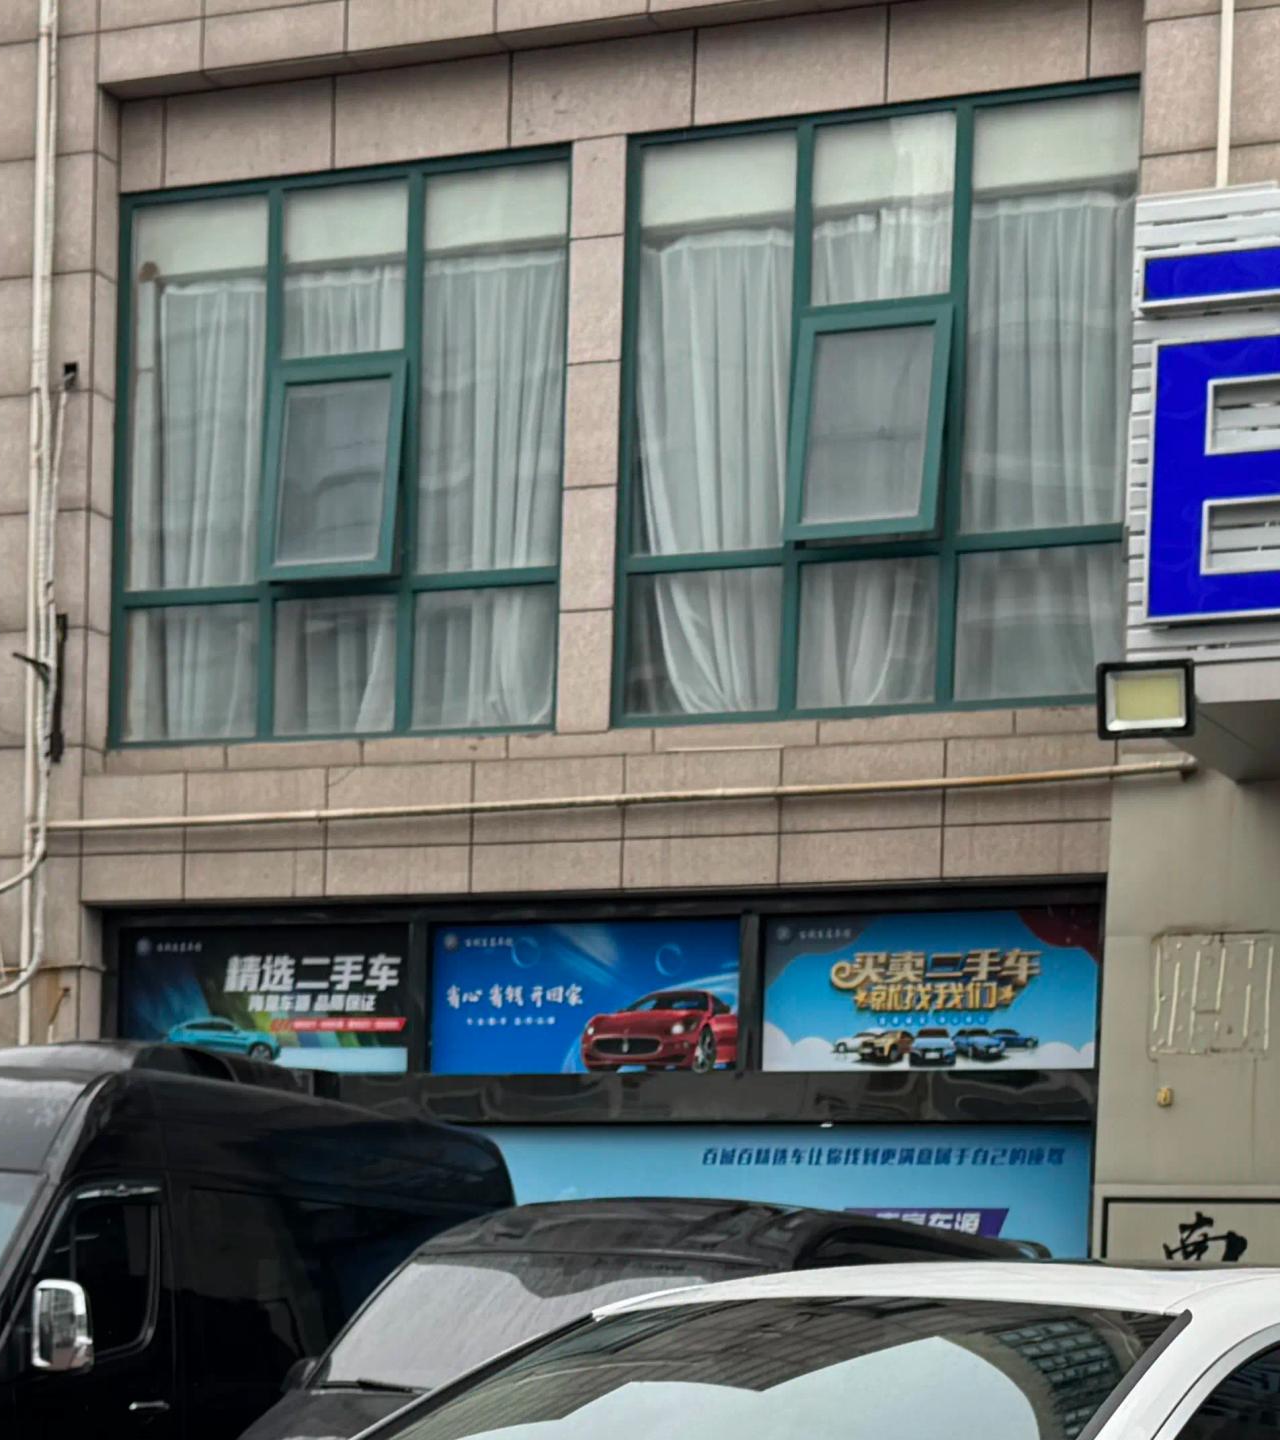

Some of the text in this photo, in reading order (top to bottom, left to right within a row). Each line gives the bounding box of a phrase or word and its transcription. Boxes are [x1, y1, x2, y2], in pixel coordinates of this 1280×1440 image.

[223, 955, 402, 993] 精选二手车
[834, 948, 1042, 988] 买卖二手车
[446, 984, 484, 1009] 省心
[869, 981, 999, 1010] 就找我们
